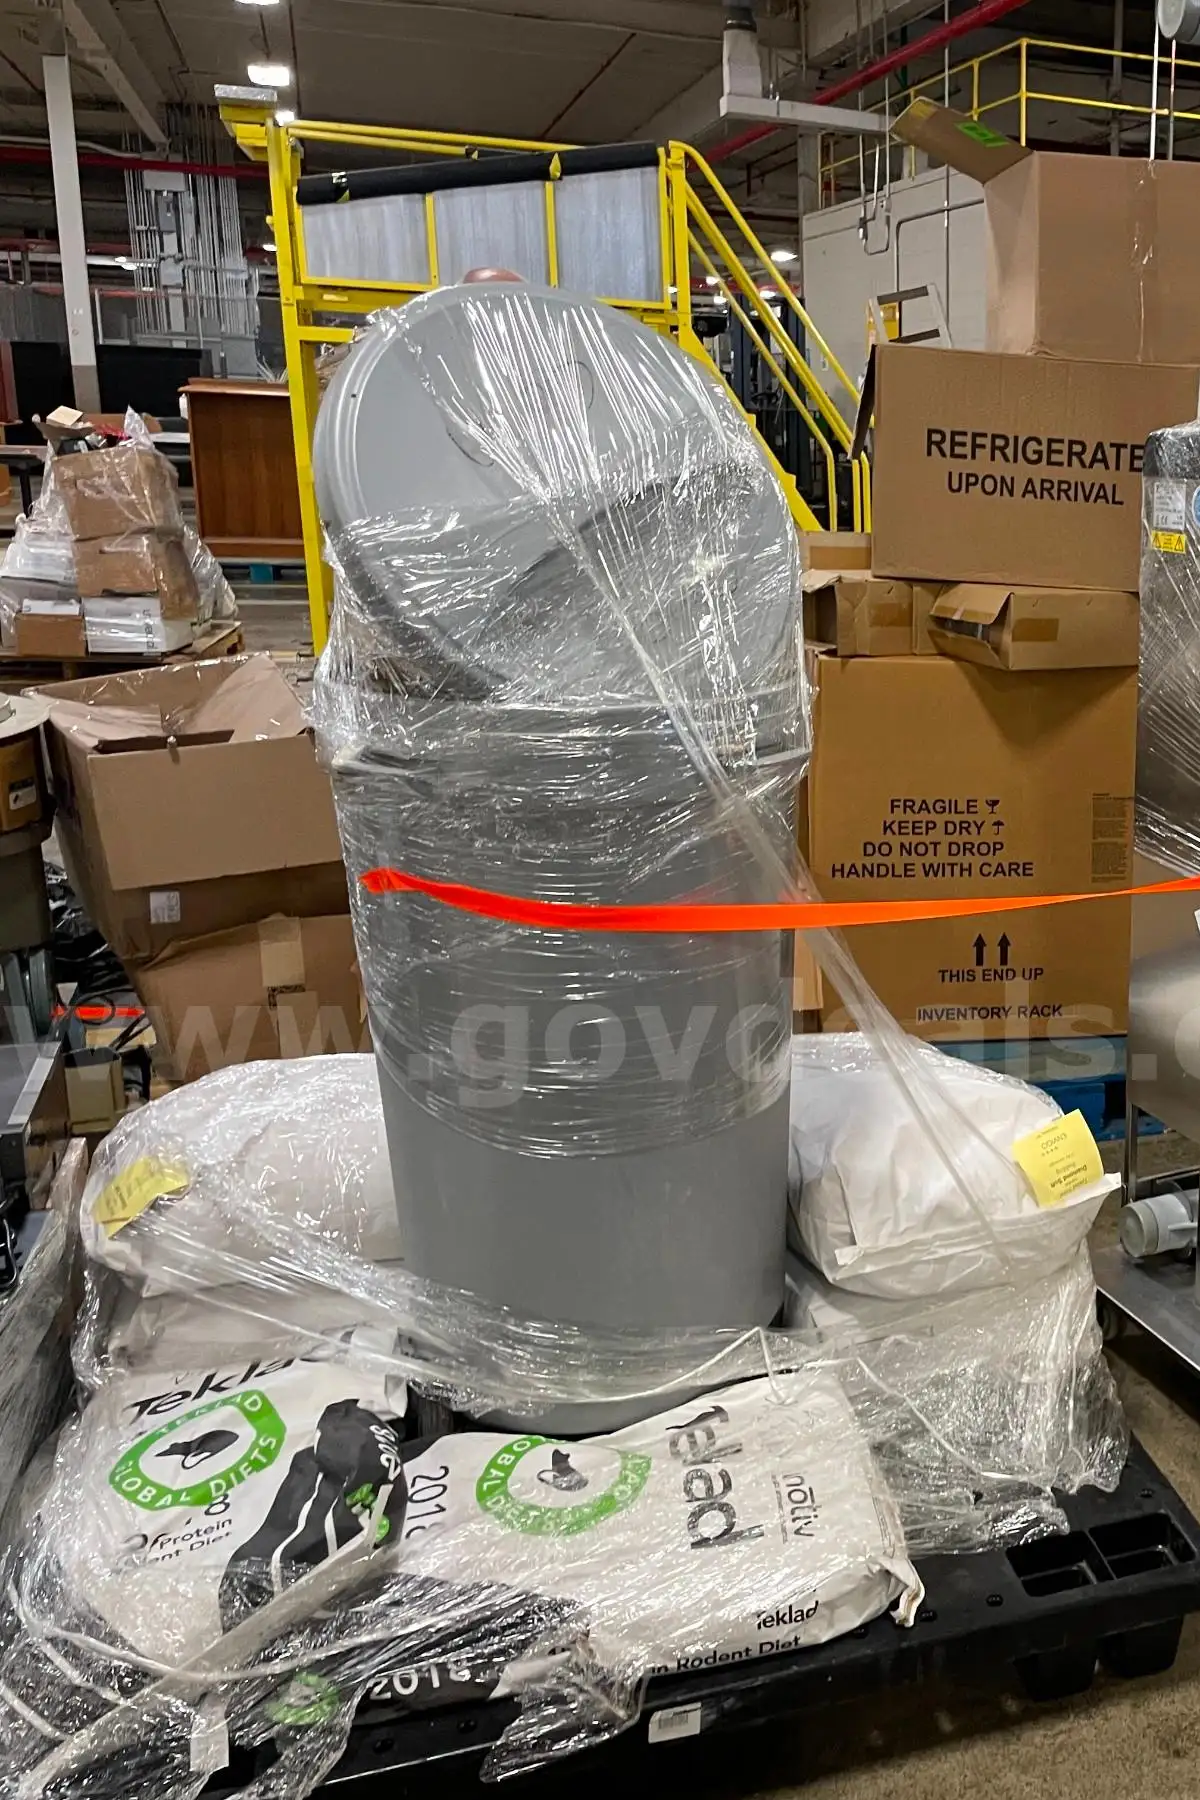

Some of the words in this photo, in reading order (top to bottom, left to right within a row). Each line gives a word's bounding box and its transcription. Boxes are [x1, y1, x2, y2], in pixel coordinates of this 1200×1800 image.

[926, 428, 1145, 473] REFRIGERATE
[947, 471, 1014, 497] UPON
[1021, 477, 1124, 506] ARRIVAL
[890, 798, 979, 815] FRAGILE
[882, 820, 937, 836] KEEP
[944, 820, 985, 836] DRY
[863, 841, 893, 857] DO
[899, 841, 941, 857] NOT
[948, 841, 1005, 857] DROP
[831, 863, 916, 879] HANDLE
[922, 862, 973, 878] WITH
[979, 861, 1034, 878] CARE
[938, 969, 977, 983] THIS
[982, 967, 1017, 982] END
[1022, 967, 1044, 981] UP
[917, 1005, 1013, 1021] INVENTORY
[1017, 1004, 1063, 1018] RACK
[676, 1646, 752, 1671] Rodent
[759, 1635, 802, 1654] Diet
